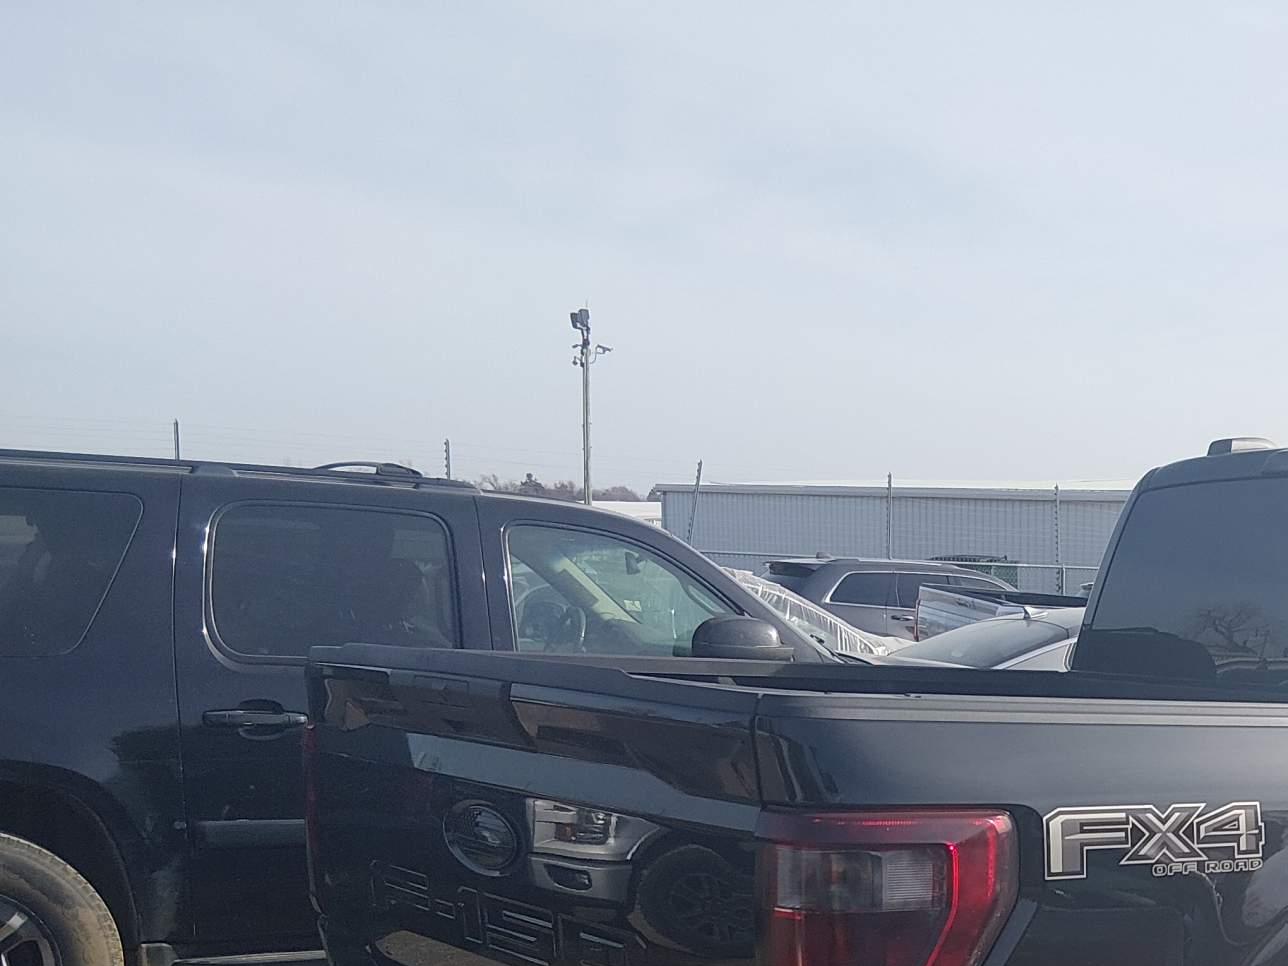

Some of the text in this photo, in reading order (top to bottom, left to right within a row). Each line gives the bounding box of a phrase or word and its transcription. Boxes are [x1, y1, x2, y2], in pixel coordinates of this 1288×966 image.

[1043, 801, 1266, 881] FX4
[1152, 858, 1263, 877] OFF ROAD
